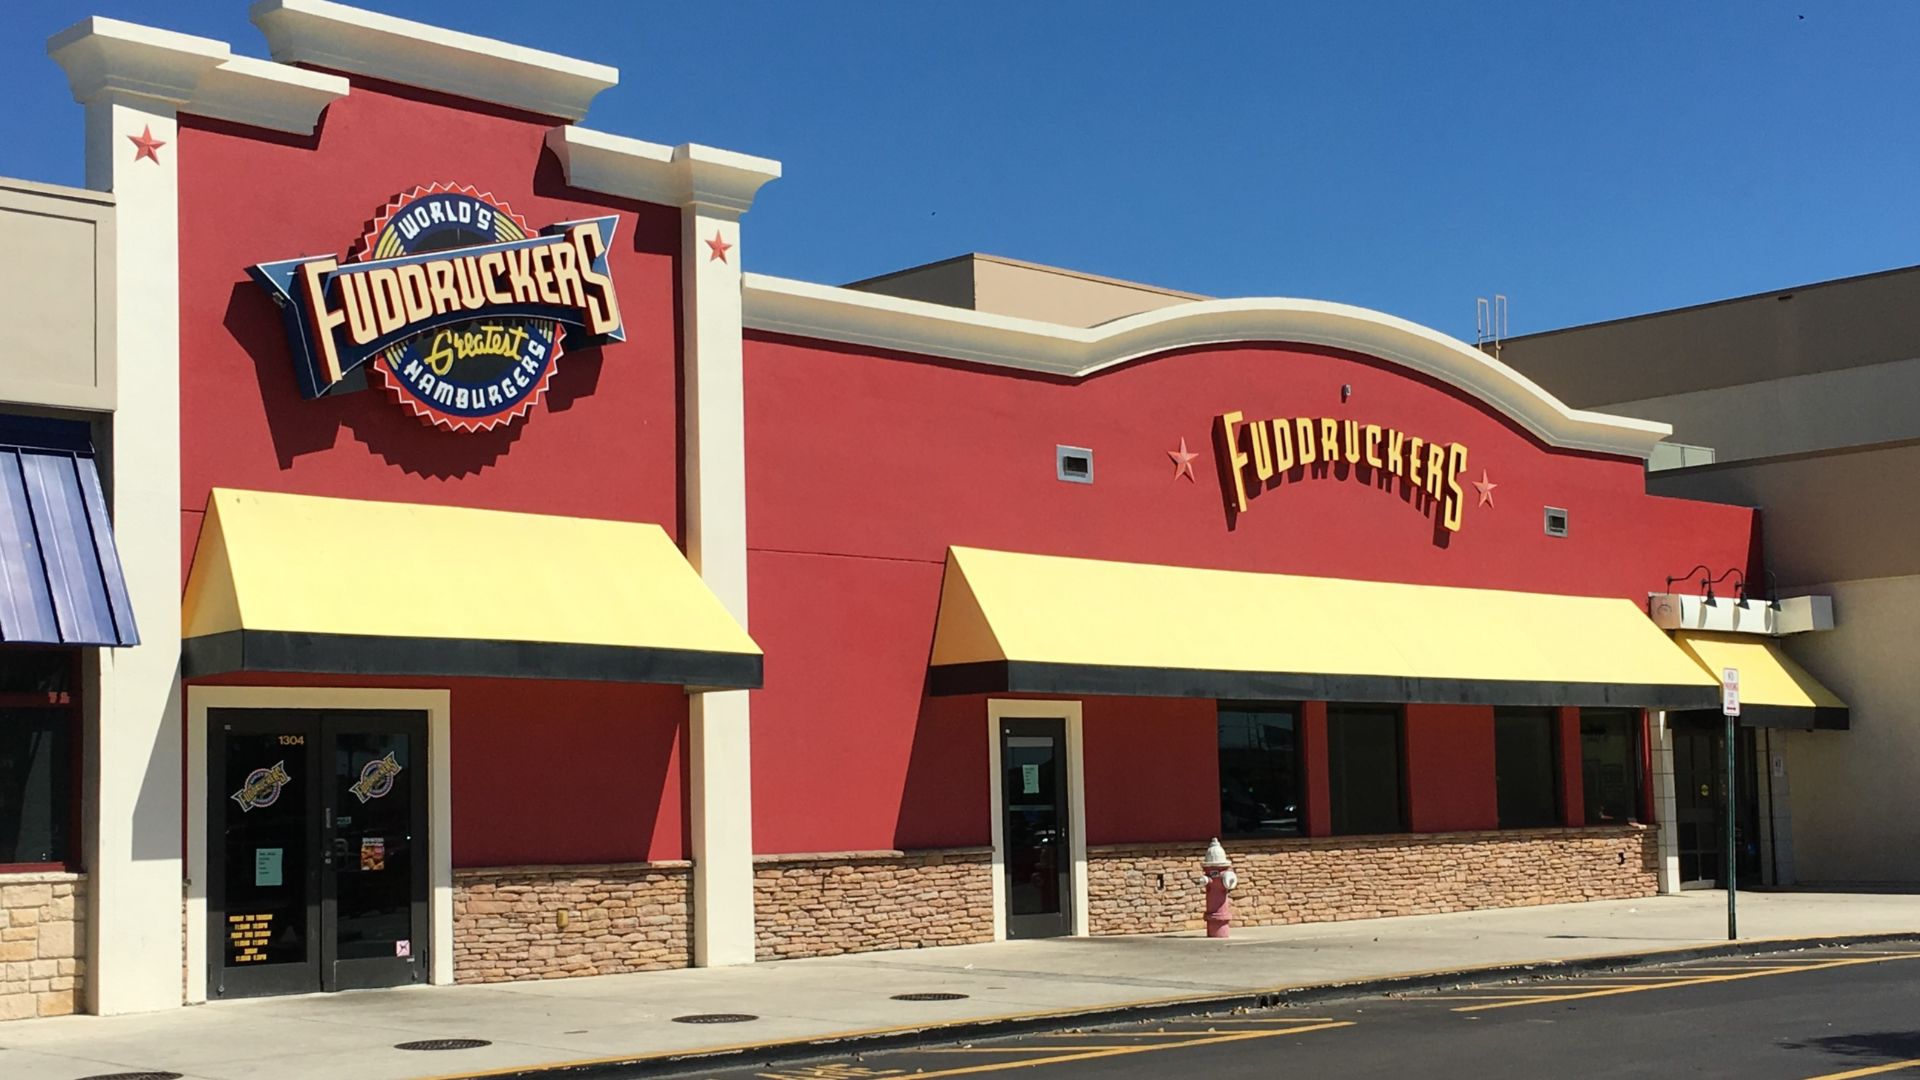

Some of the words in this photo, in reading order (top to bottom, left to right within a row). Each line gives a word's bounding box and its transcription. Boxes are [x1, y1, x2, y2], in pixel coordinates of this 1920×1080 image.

[397, 200, 492, 240] WORLD'S
[304, 222, 621, 383] FUDDRUCKERS
[403, 339, 546, 409] HAMBURGERS
[1222, 410, 1468, 532] FUDDRUCKERS
[278, 735, 305, 746] 1304
